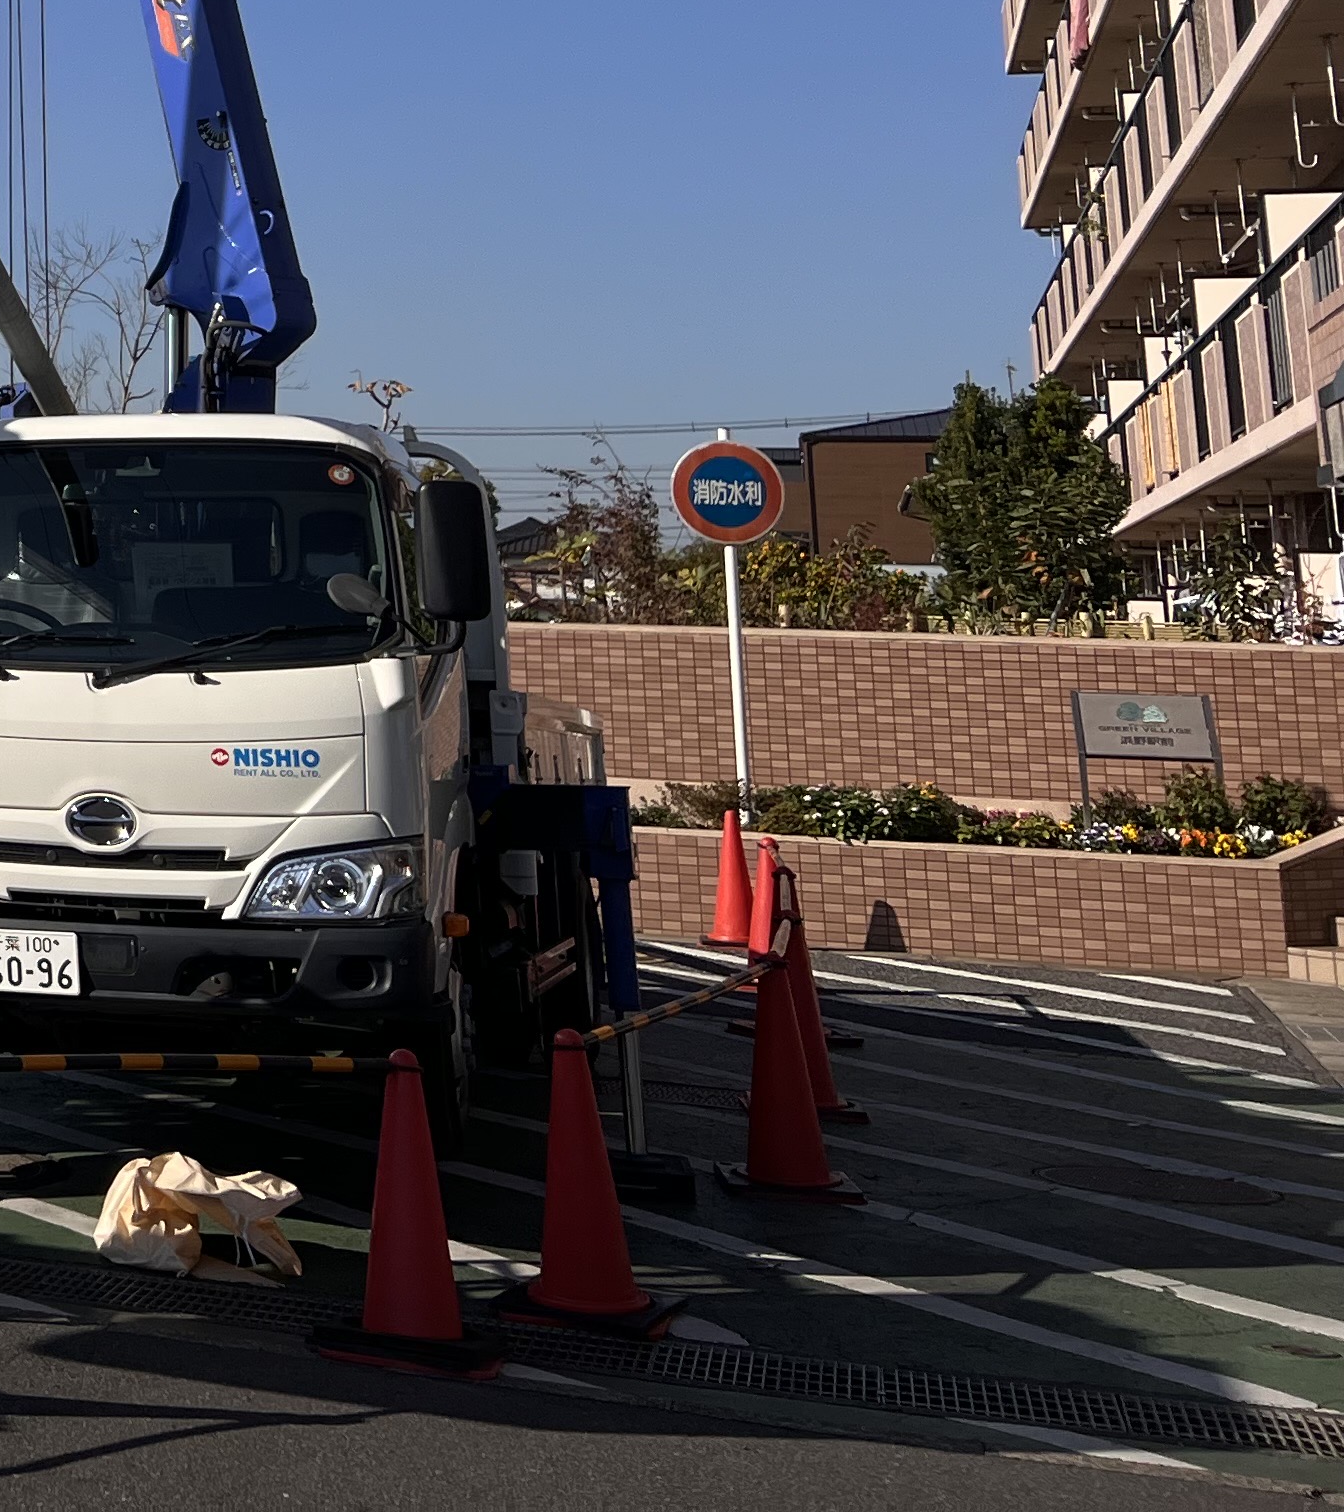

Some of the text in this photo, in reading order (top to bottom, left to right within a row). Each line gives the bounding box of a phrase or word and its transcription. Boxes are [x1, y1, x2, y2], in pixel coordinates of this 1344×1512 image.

[692, 478, 762, 507] 消防水利
[232, 747, 321, 769] NISHIO
[233, 768, 258, 777] RENT
[259, 769, 277, 778] ALL
[300, 769, 321, 778] LTD.
[25, 935, 52, 954] 100
